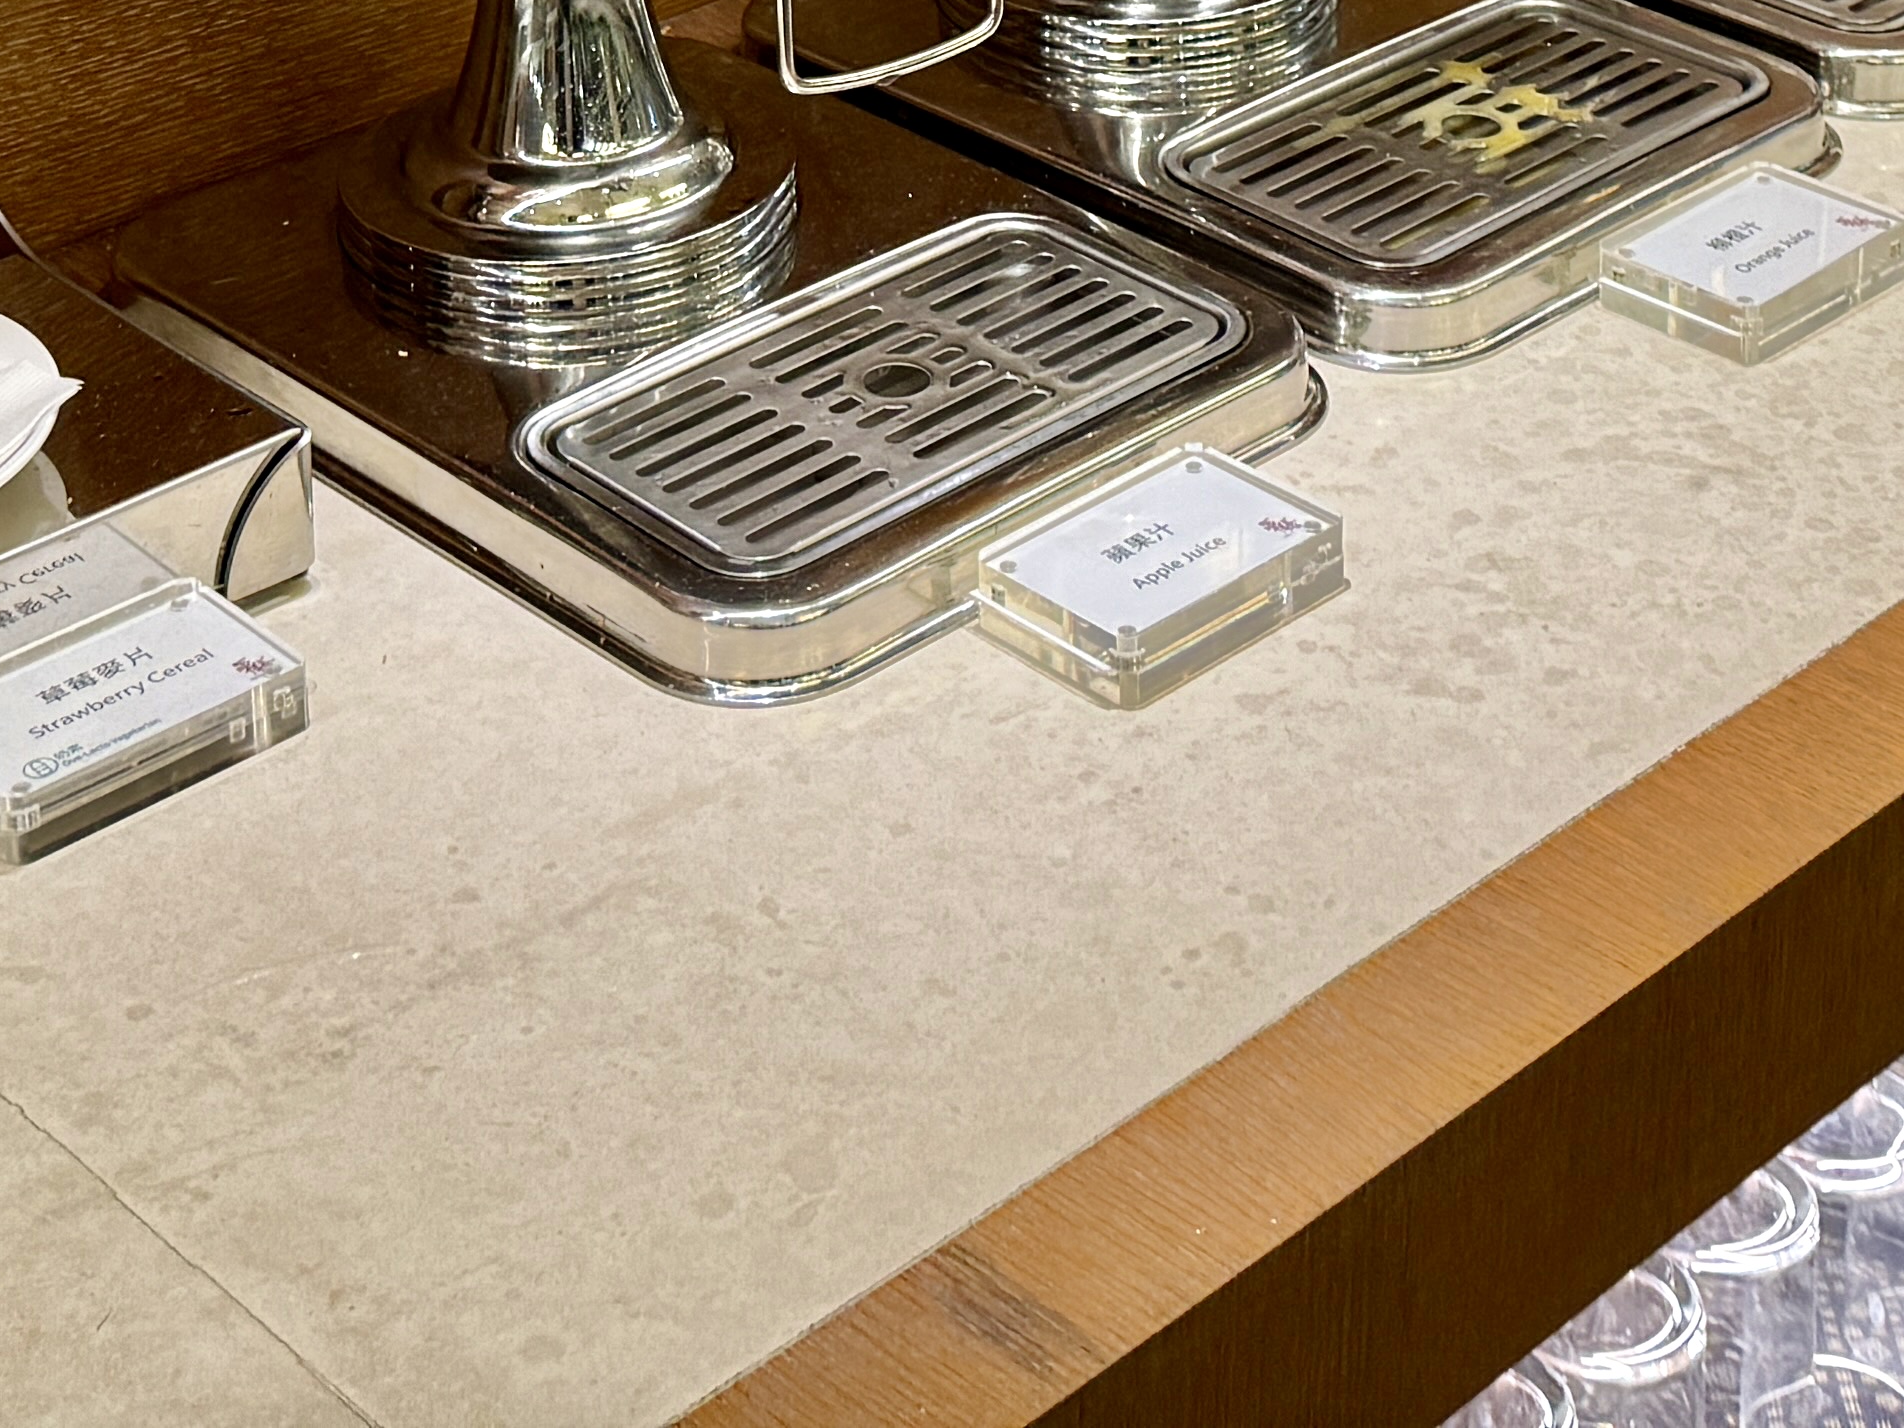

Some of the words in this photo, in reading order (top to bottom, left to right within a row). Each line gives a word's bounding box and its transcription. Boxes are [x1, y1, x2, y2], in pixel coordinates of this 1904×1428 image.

[1734, 245, 1786, 274] Orange
[1100, 522, 1174, 565] 蘋果汁
[1132, 559, 1185, 590] Apple
[1181, 536, 1227, 563] Juice
[28, 680, 145, 740] Strawberry
[147, 648, 215, 685] Cereal
[34, 646, 153, 705] 草莓麥片
